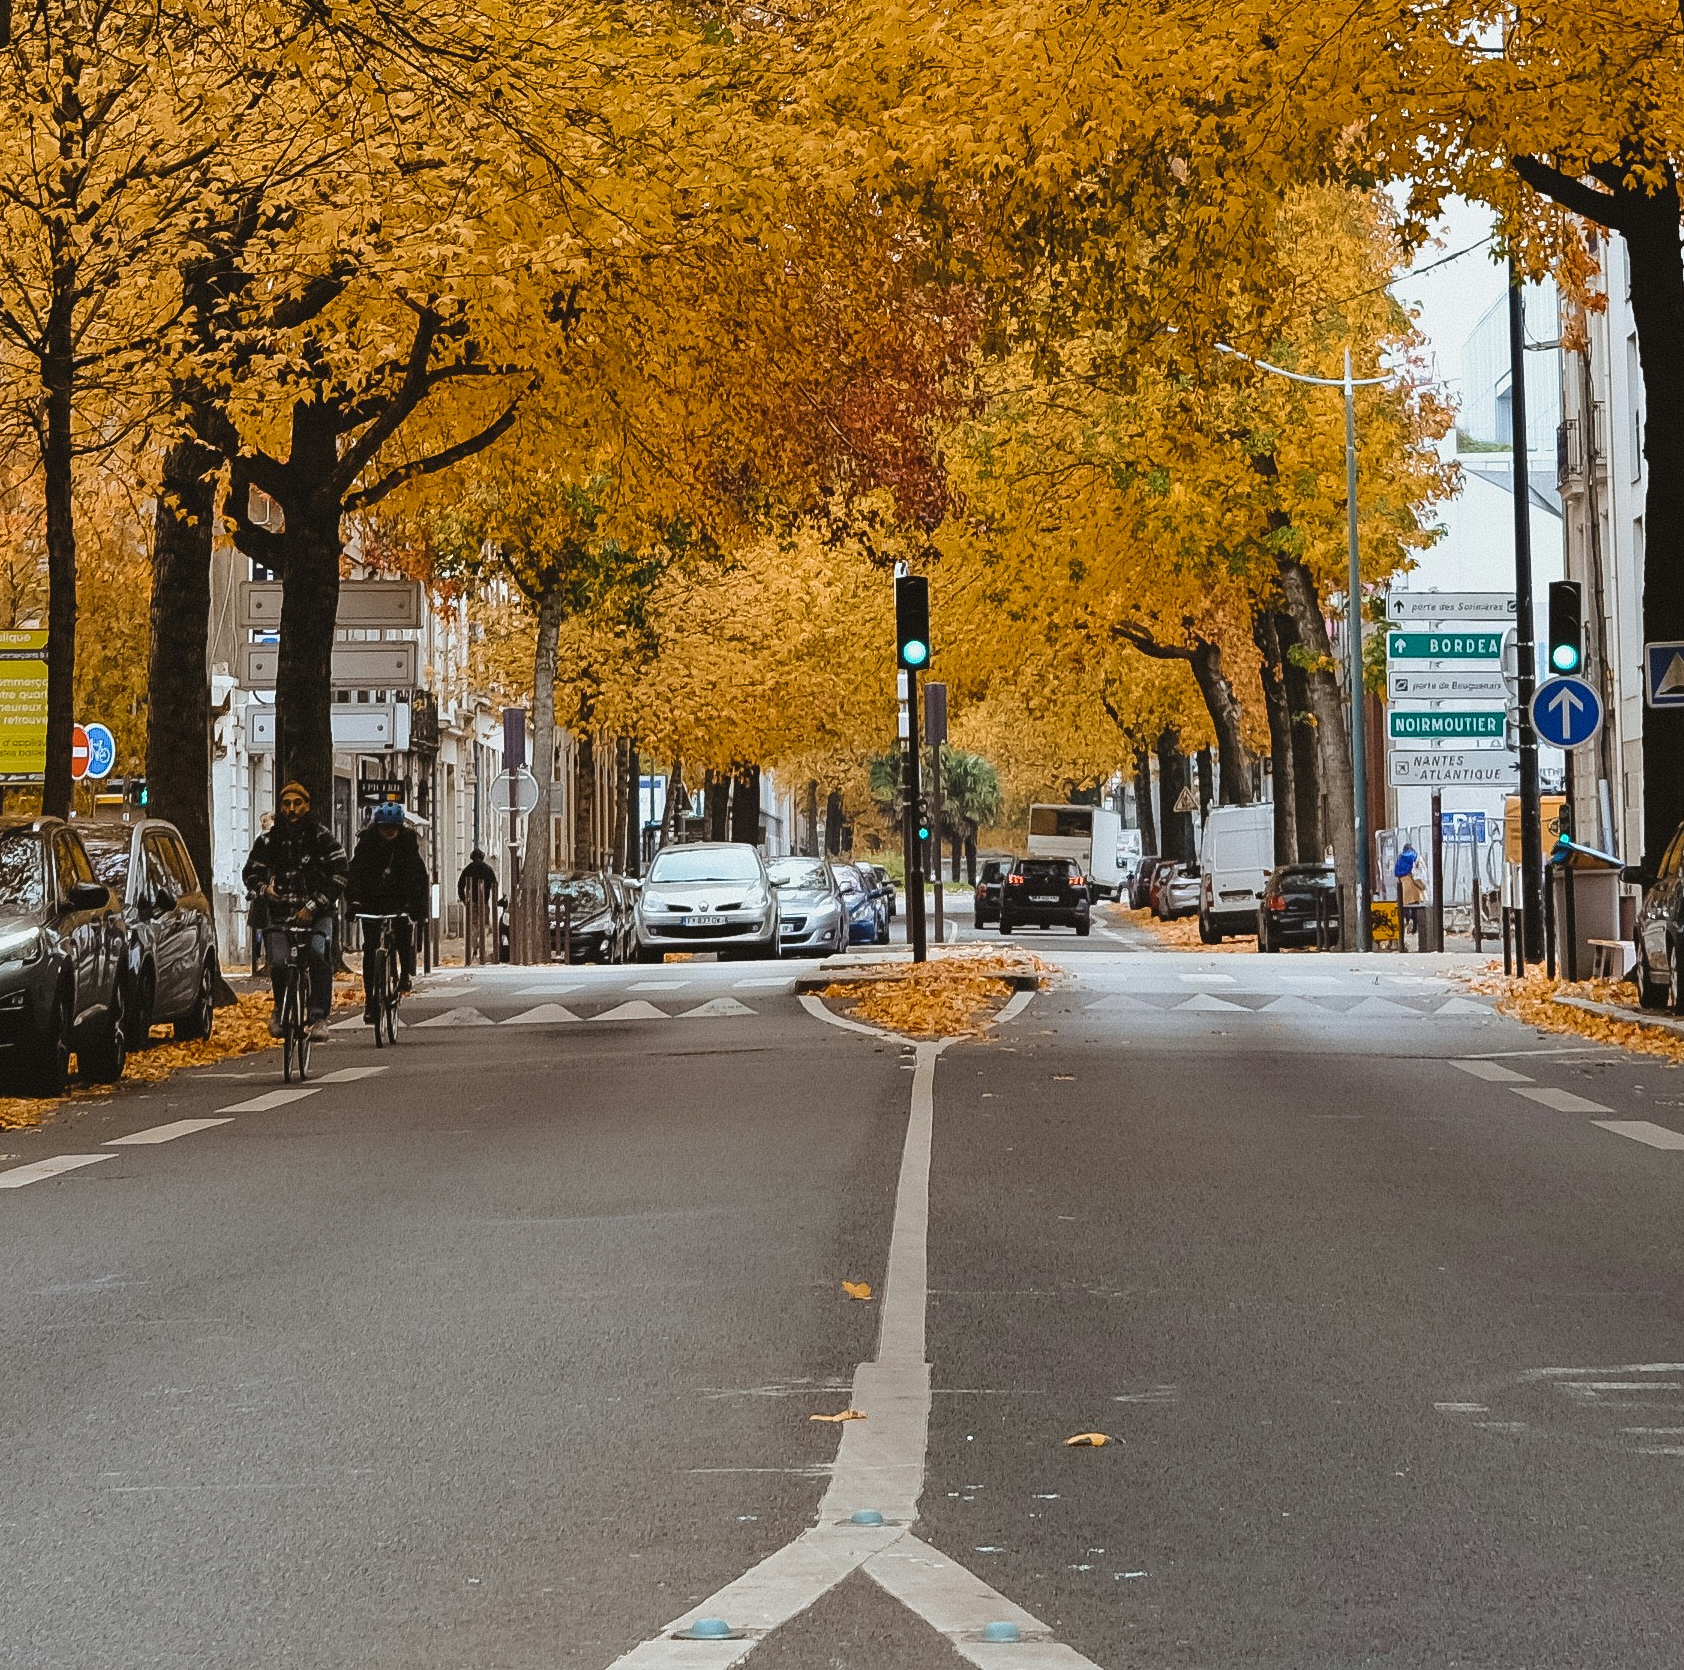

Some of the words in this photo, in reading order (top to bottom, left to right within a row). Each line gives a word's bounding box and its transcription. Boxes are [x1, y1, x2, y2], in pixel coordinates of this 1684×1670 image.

[1429, 638, 1499, 653] BORDEA
[1395, 716, 1497, 732] NOIRMOUTIER
[1413, 755, 1465, 767] NANTES
